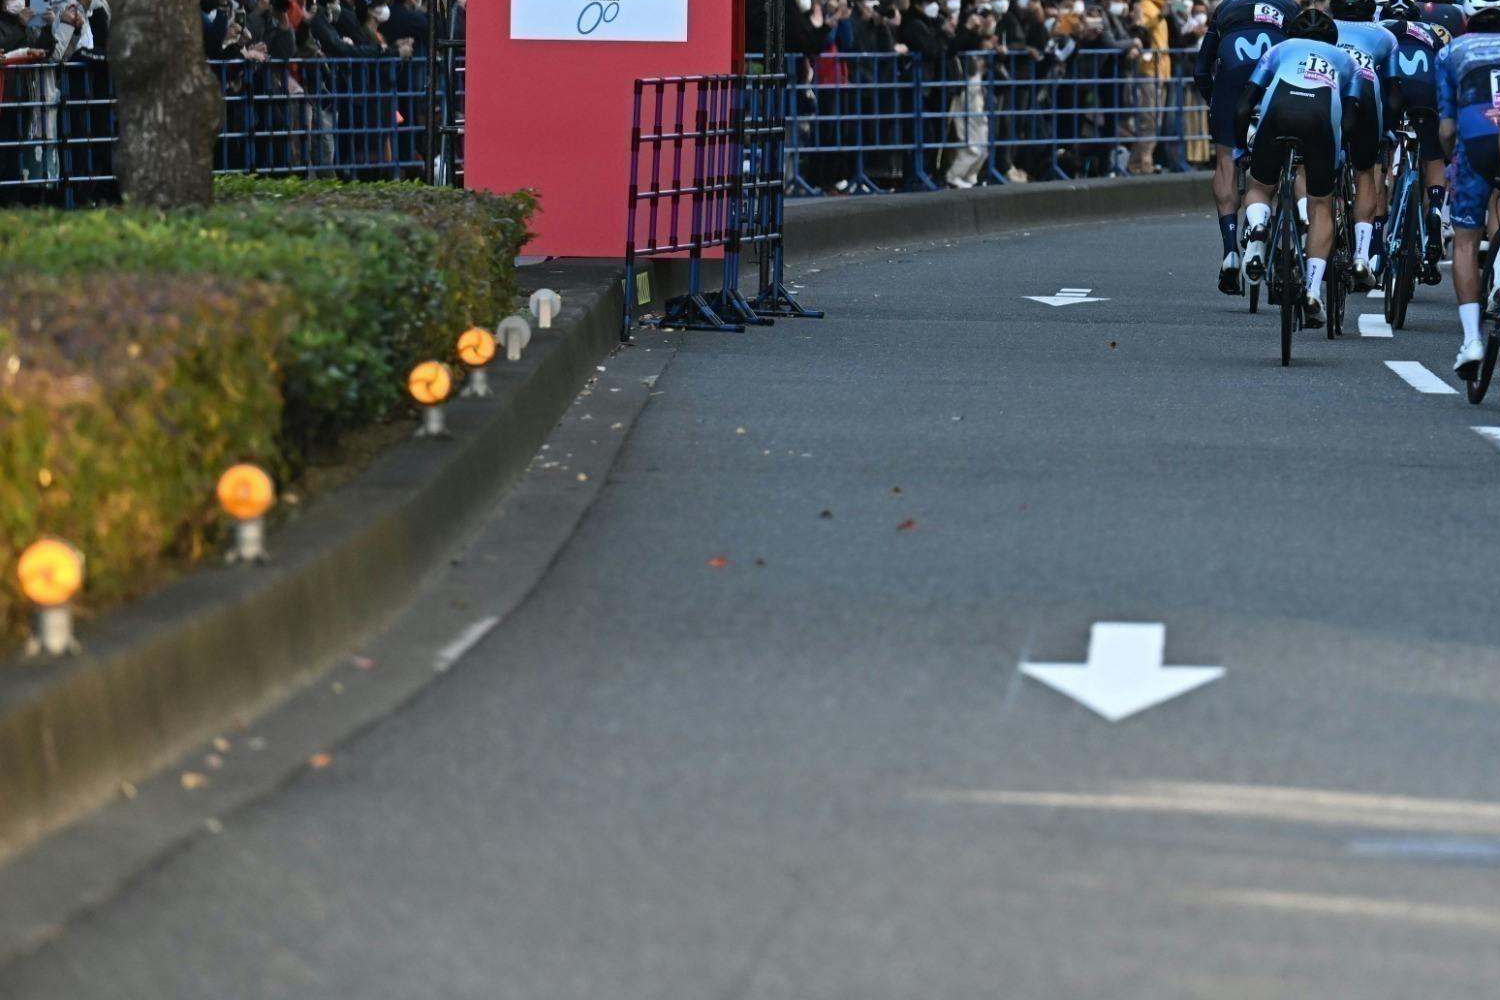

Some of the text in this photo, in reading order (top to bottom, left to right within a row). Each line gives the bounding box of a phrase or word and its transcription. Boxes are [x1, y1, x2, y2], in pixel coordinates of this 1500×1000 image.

[1262, 5, 1279, 20] 62
[1309, 58, 1335, 80] 134
[1346, 50, 1373, 69] 32
